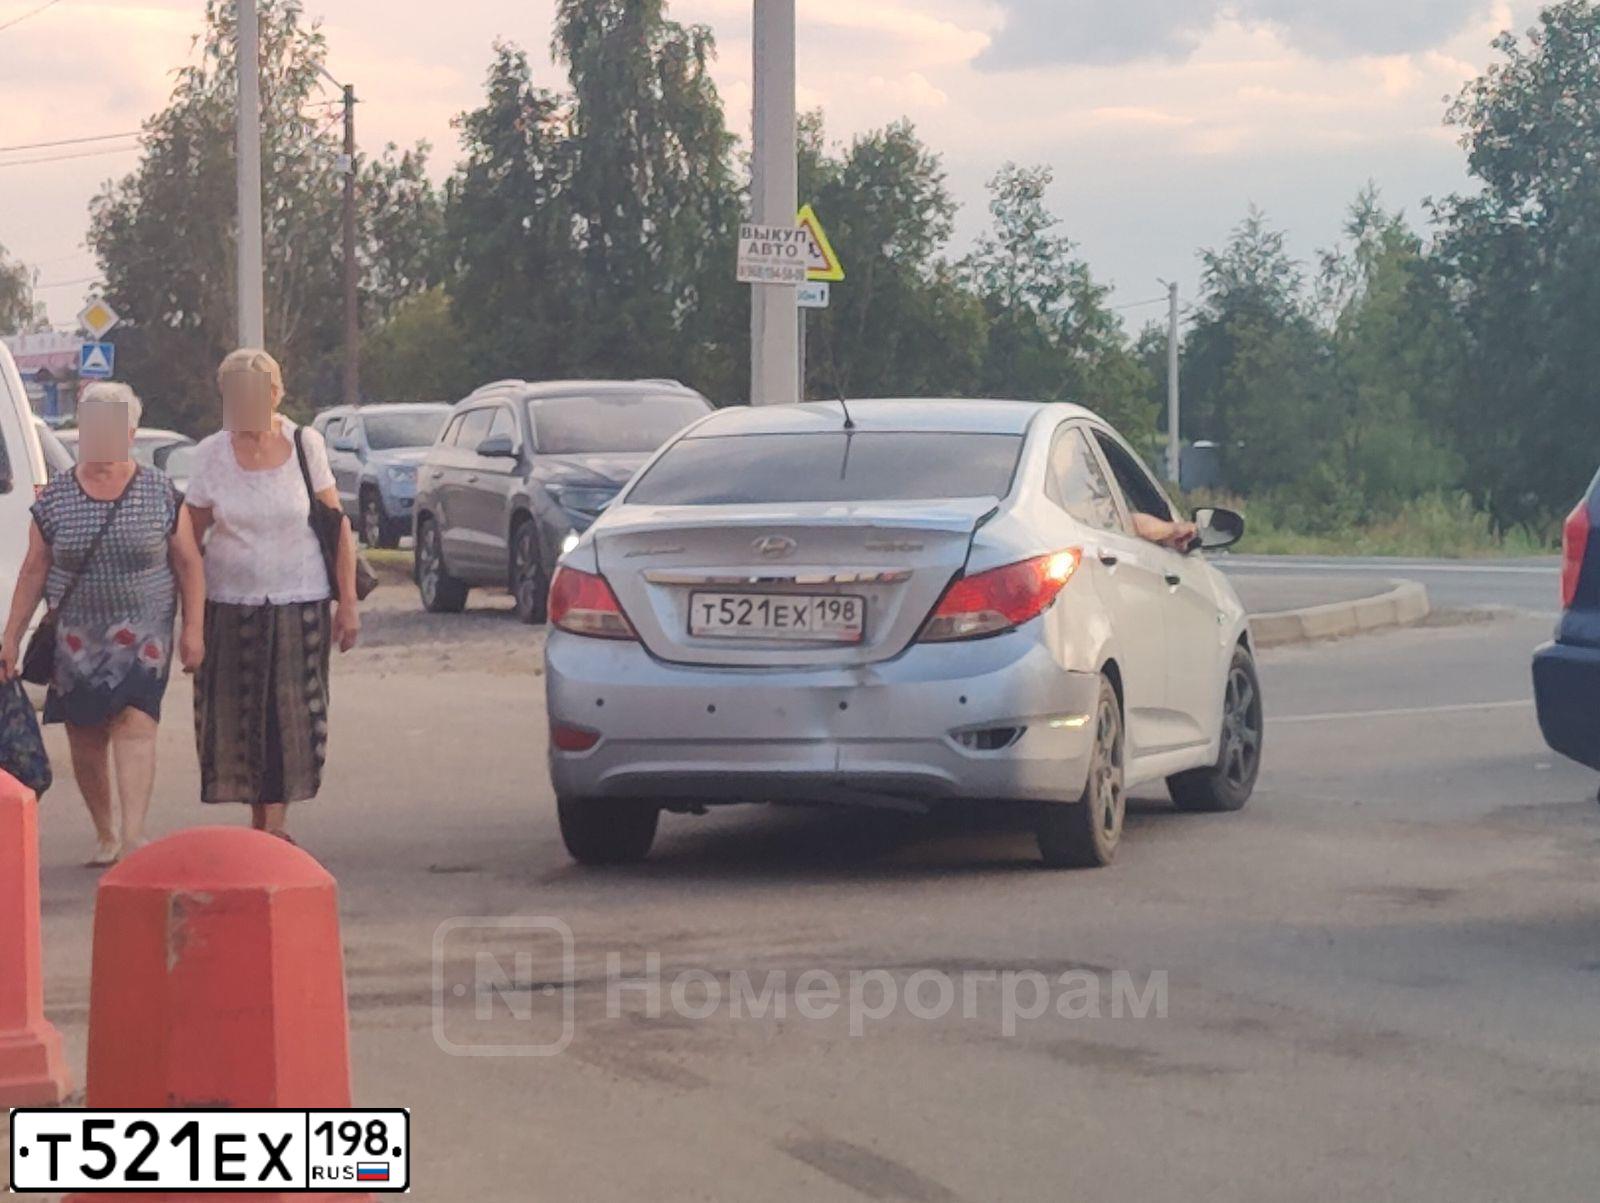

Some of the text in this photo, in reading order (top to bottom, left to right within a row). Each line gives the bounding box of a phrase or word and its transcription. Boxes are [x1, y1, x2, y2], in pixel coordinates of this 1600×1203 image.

[741, 227, 806, 242] ВЫКУП
[747, 243, 798, 257] АВТО
[816, 600, 855, 622] 198
